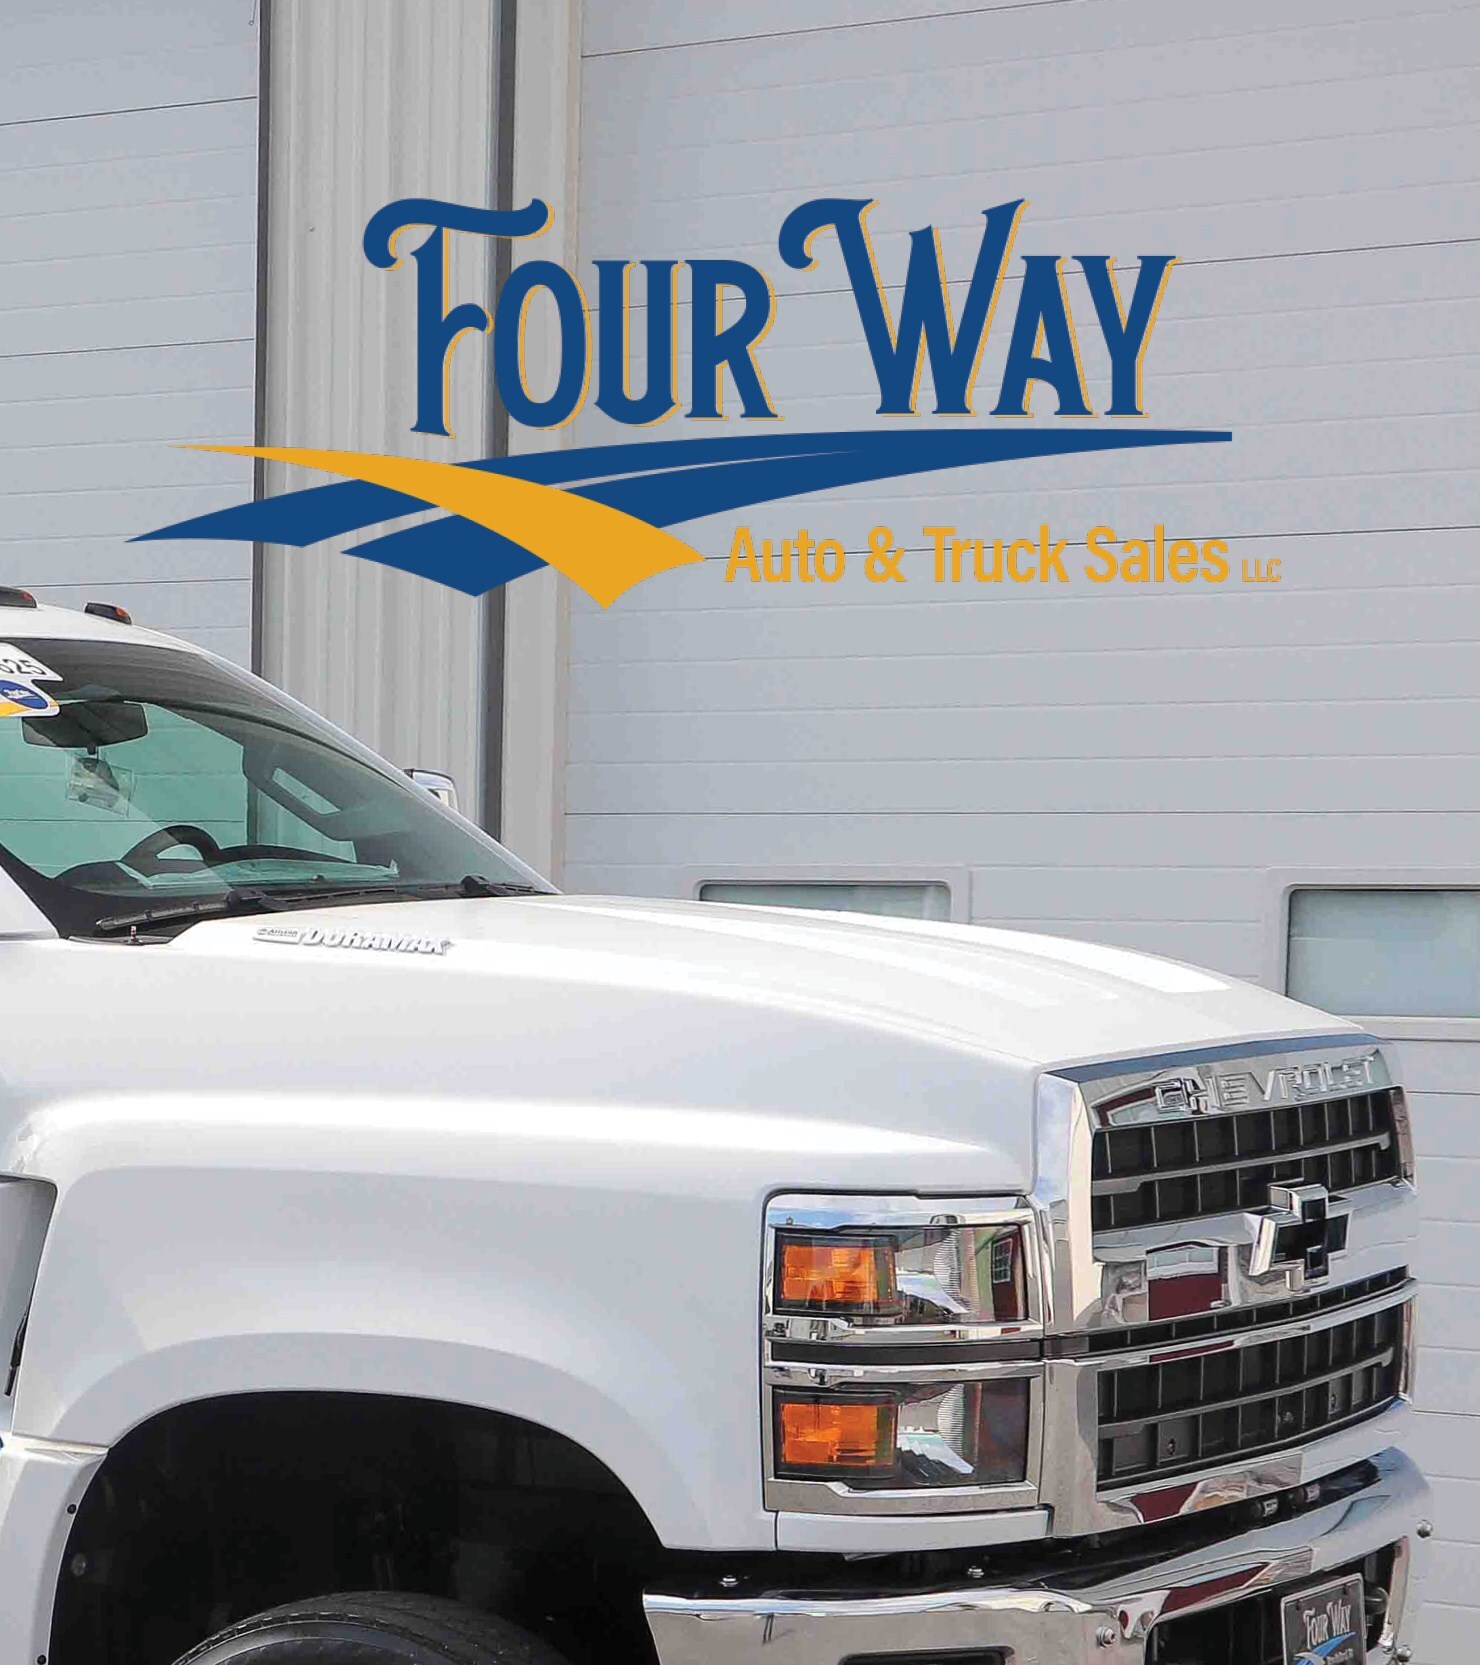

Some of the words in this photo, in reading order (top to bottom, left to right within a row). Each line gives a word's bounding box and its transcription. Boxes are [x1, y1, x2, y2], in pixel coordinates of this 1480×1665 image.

[1155, 1055, 1375, 1115] CHEVROLET
[1302, 1606, 1330, 1650] FOUR
[1326, 1598, 1352, 1637] WAY
